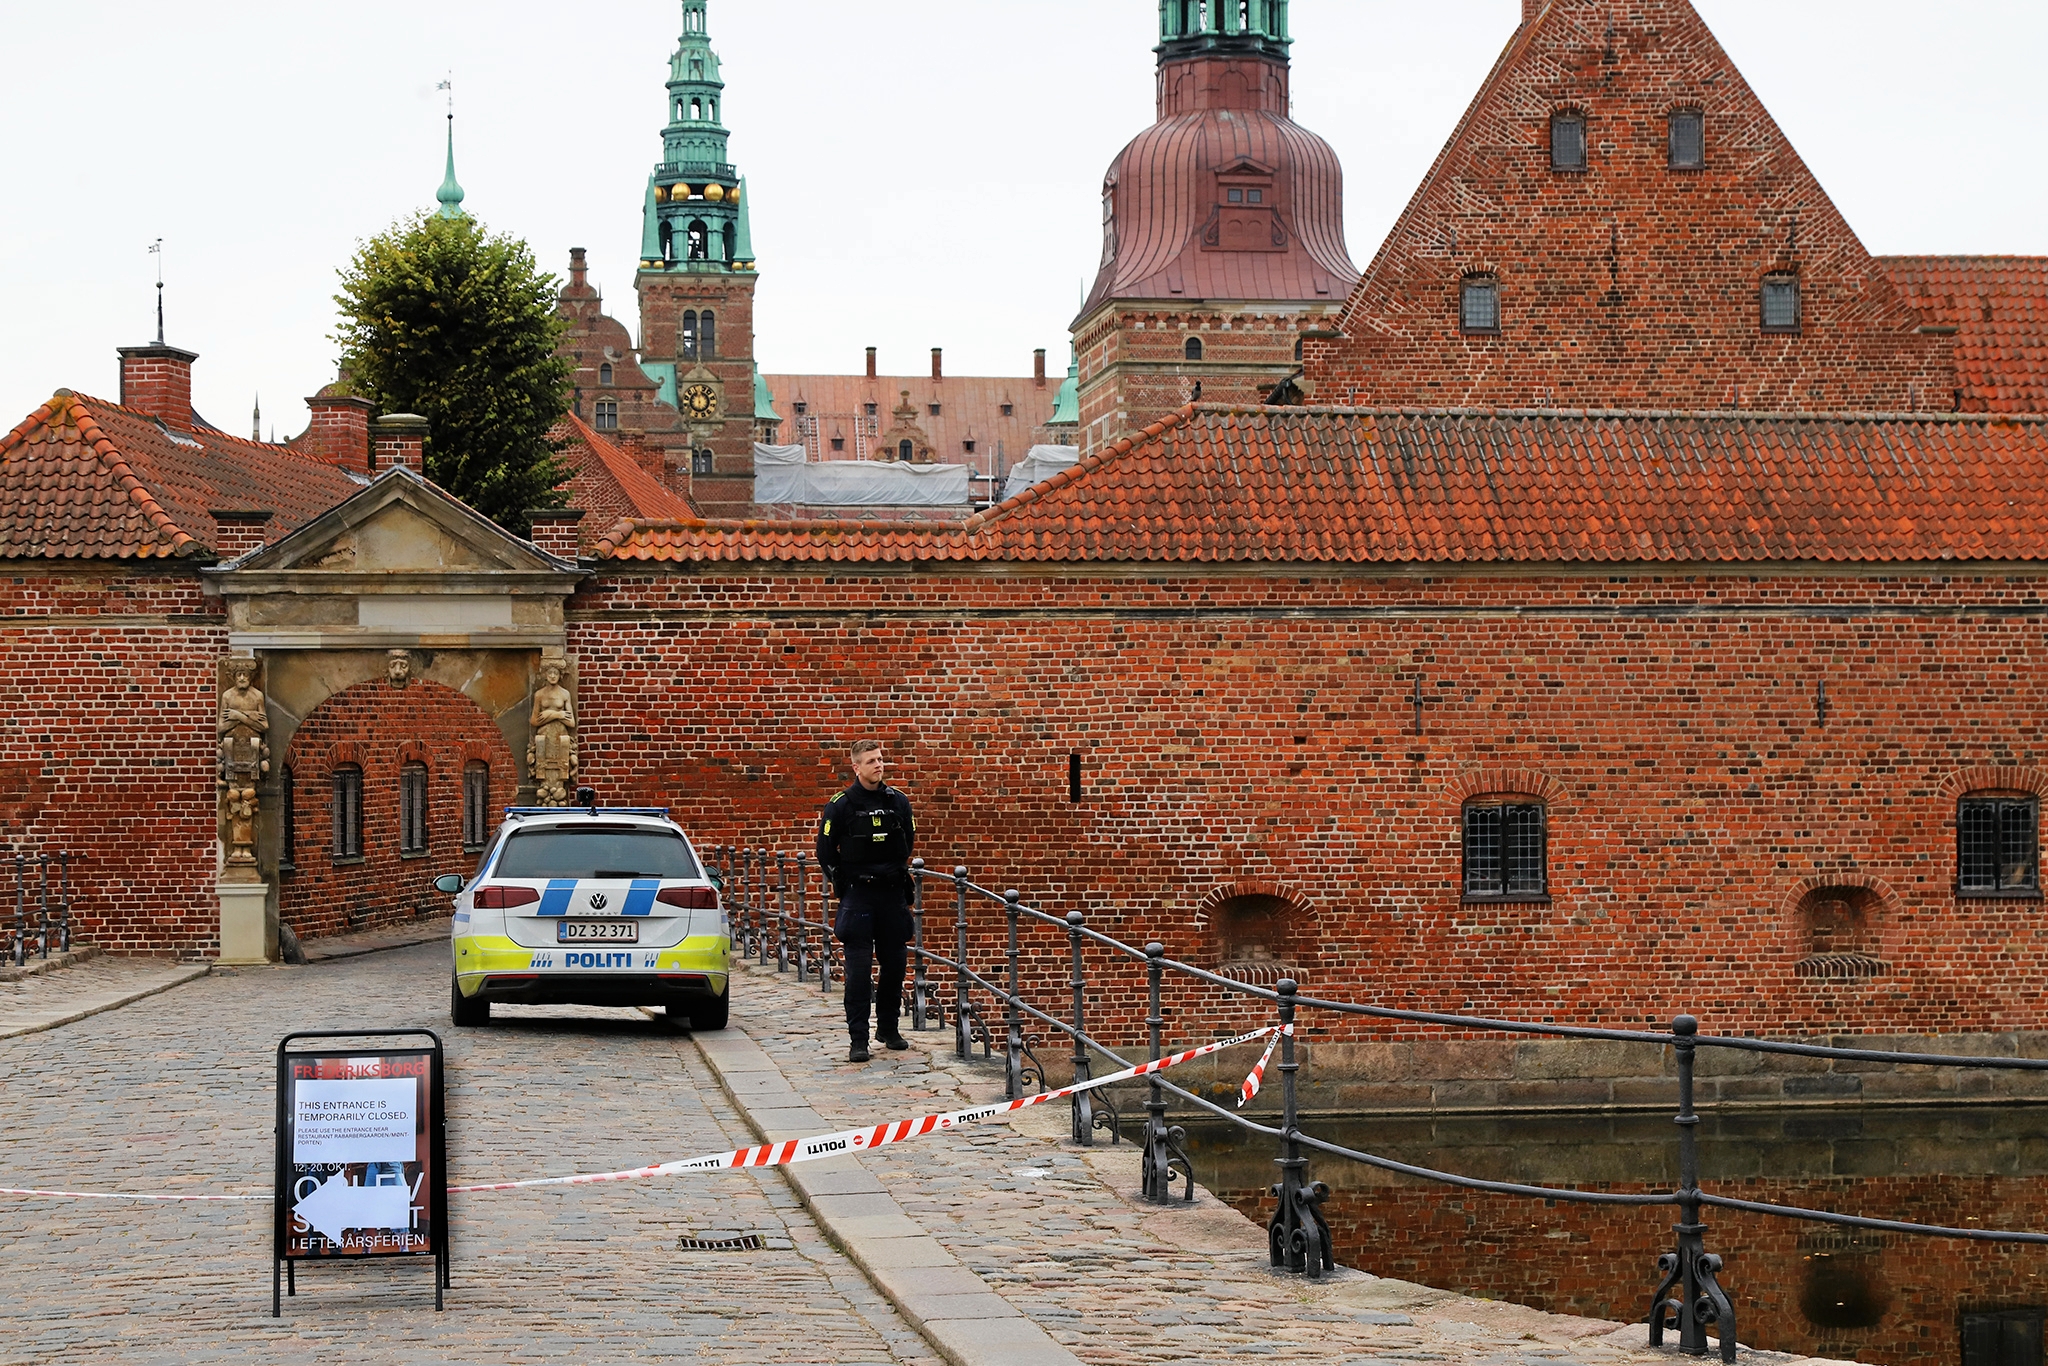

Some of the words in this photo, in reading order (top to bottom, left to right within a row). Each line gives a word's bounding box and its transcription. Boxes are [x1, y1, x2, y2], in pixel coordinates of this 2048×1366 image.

[568, 924, 587, 937] DZ
[590, 924, 607, 937] 32
[610, 924, 634, 937] 371
[565, 953, 632, 968] POLITI
[294, 1062, 425, 1078] FREDERIKSBORG
[299, 1101, 321, 1110] THIS
[323, 1101, 375, 1110] ENTRANCE
[378, 1100, 387, 1109] IS
[298, 1112, 365, 1122] TEMPORARILY
[367, 1111, 409, 1121] CLOSED.
[807, 1139, 847, 1155] POLITI
[292, 1238, 295, 1249] I
